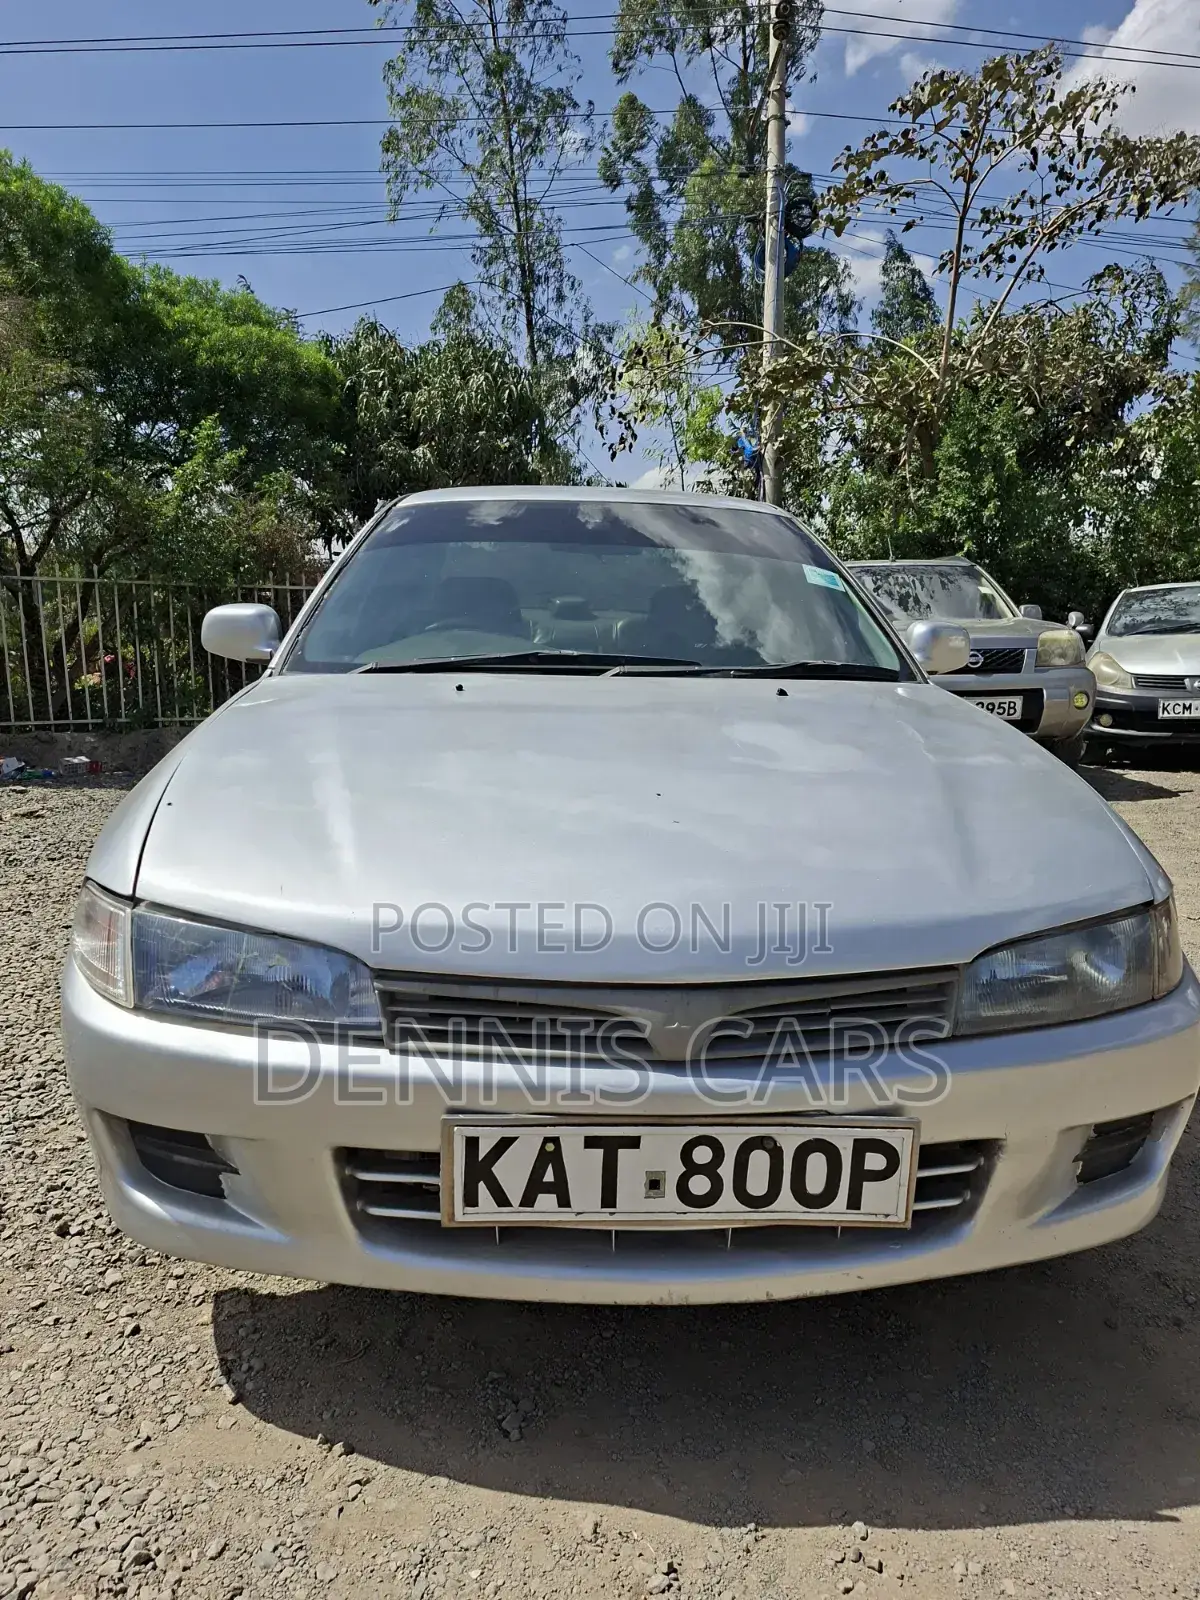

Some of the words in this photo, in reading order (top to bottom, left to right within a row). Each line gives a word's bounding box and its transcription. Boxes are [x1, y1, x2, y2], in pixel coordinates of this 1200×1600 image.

[1162, 702, 1192, 715] KCM
[463, 1135, 641, 1209] KAT
[676, 1134, 900, 1211] 800P
